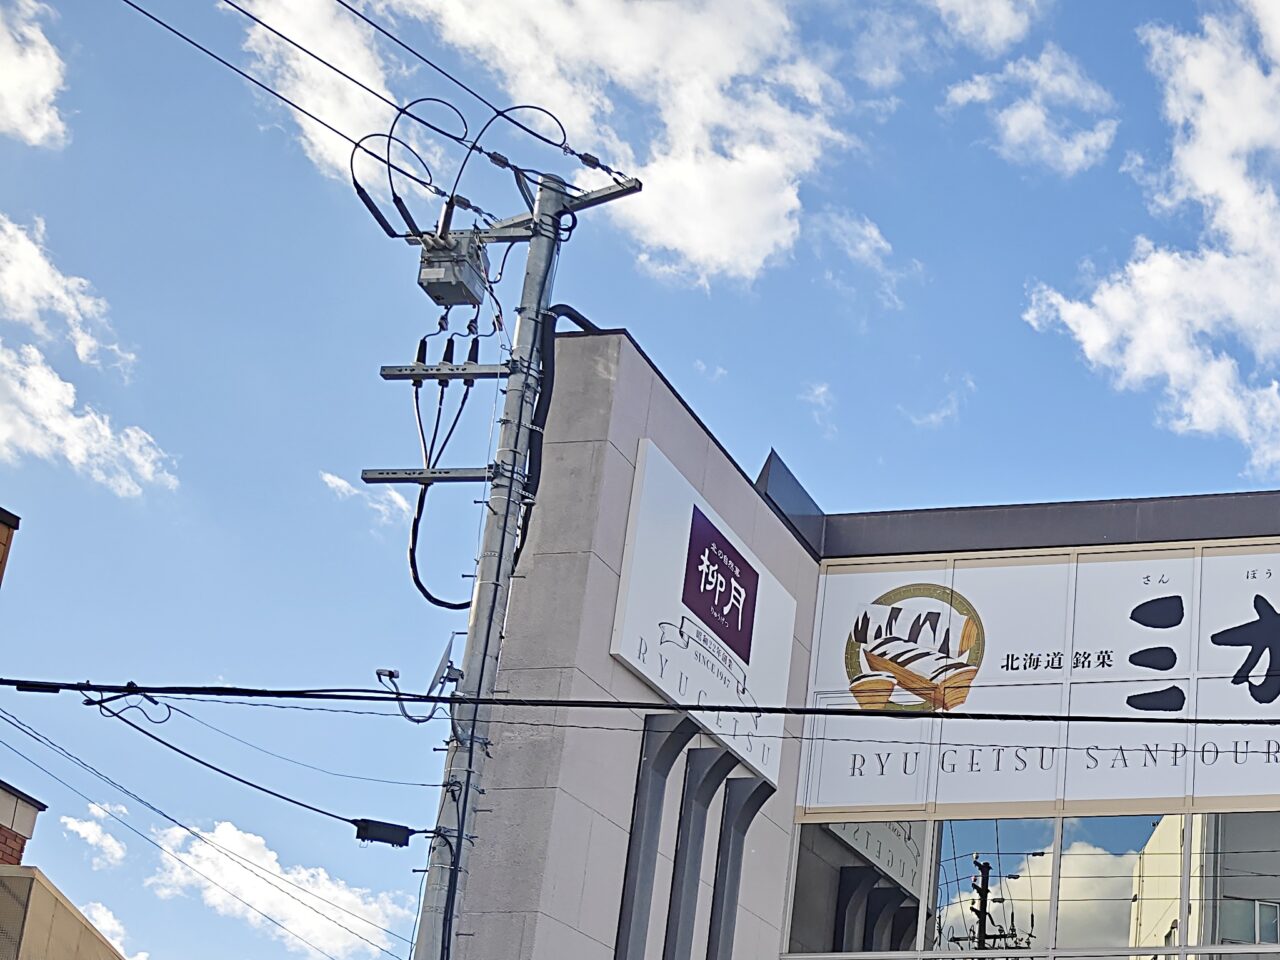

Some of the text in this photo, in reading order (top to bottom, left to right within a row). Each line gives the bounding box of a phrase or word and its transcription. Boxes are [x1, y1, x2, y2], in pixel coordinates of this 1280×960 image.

[698, 548, 746, 631] 柳月
[1142, 573, 1170, 585] さん
[694, 651, 731, 689] SINCE 1947
[1000, 650, 1114, 671] 北海道銘菓
